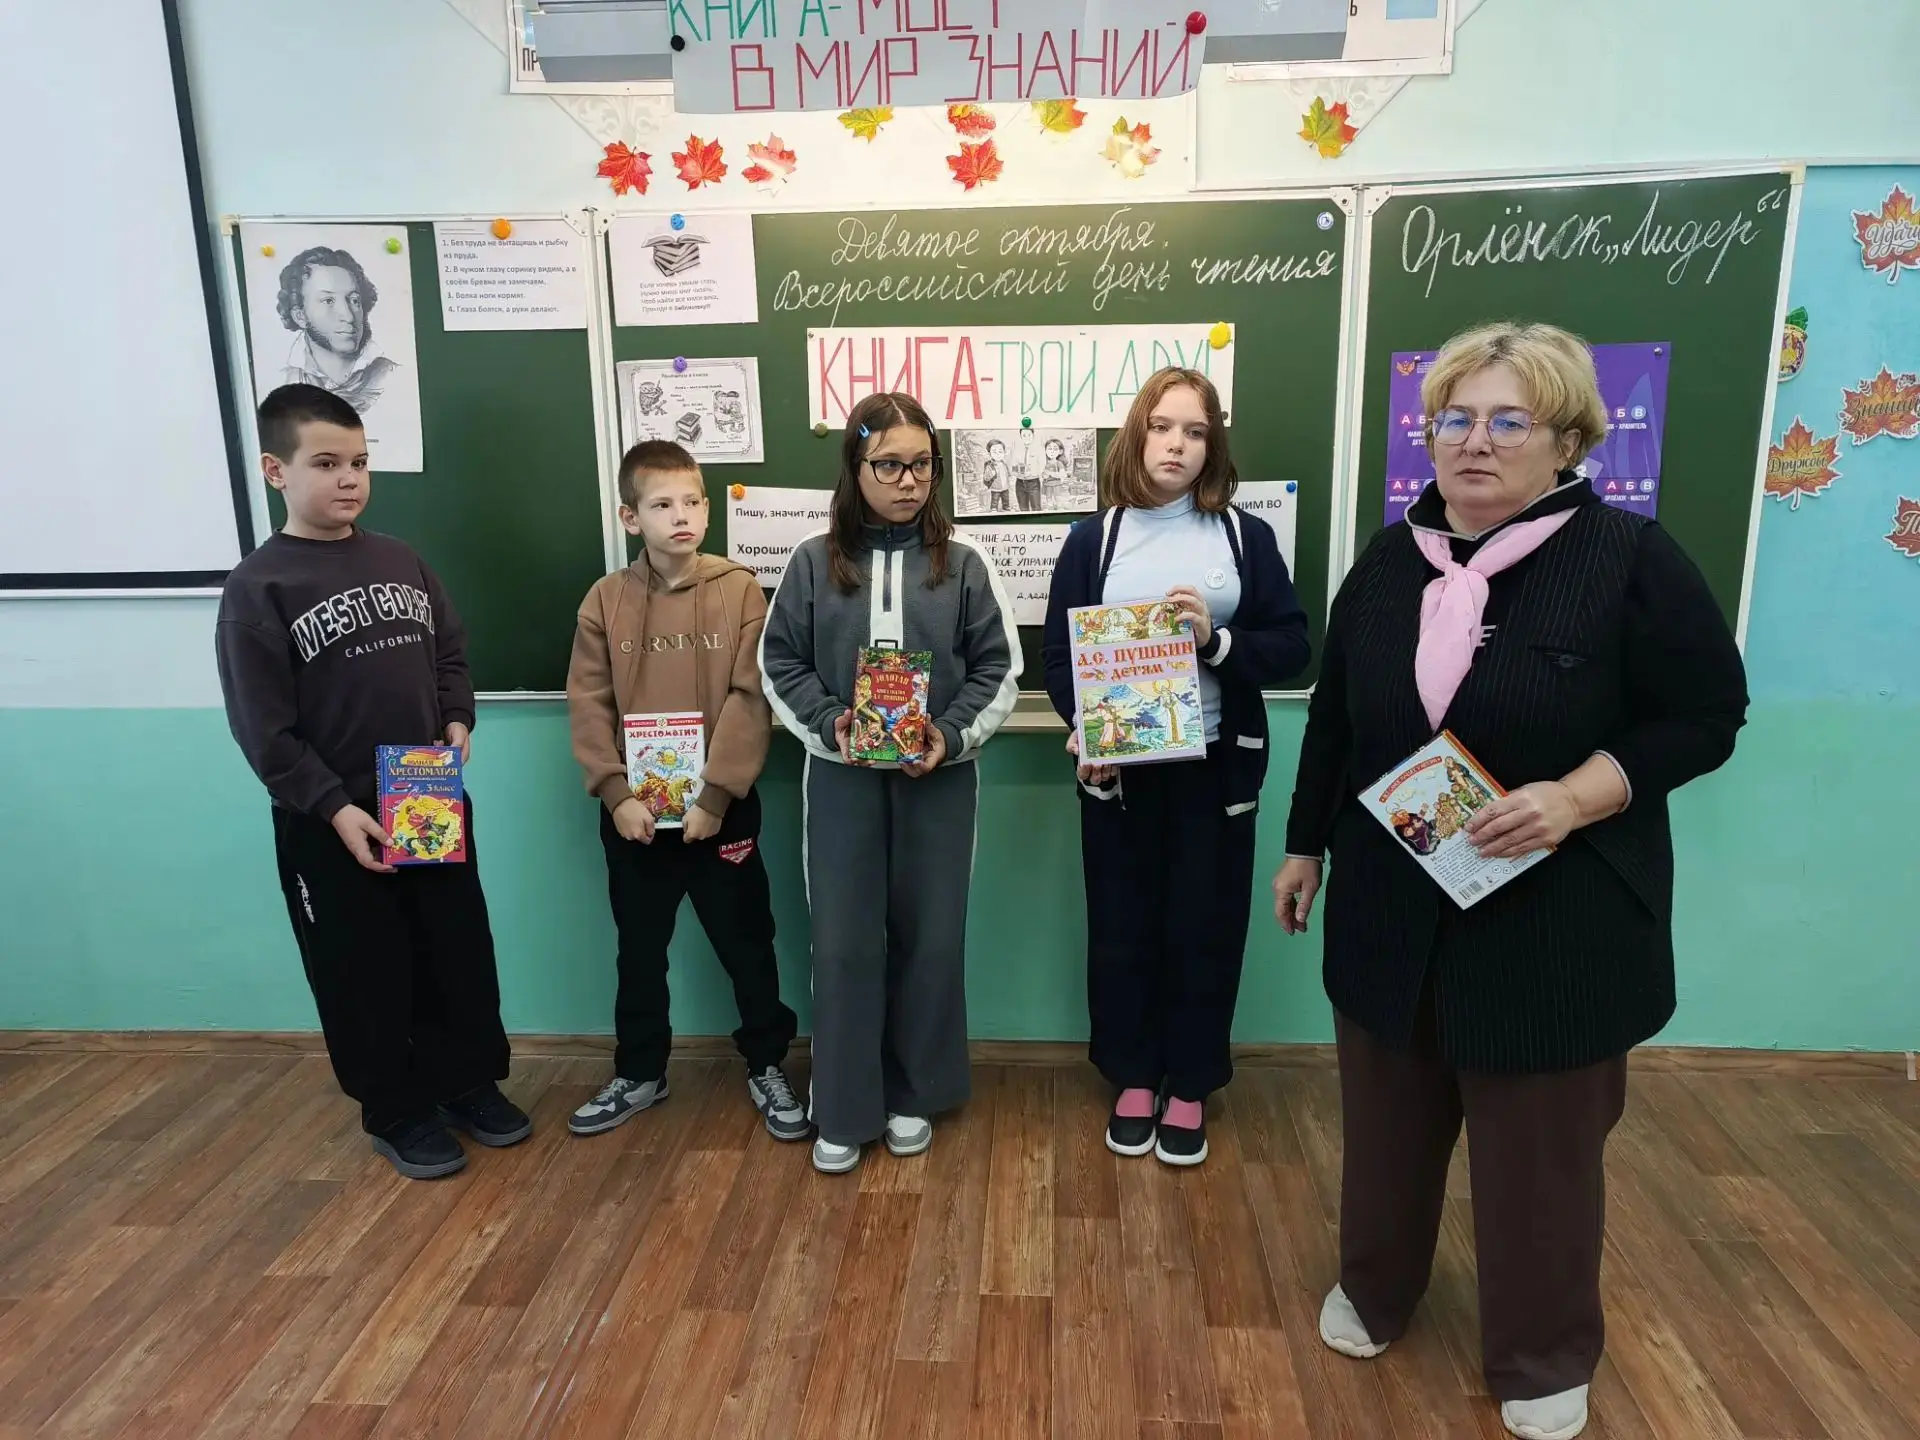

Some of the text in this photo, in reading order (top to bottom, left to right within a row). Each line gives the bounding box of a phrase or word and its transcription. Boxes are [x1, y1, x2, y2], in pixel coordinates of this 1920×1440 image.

[731, 44, 775, 111] В
[796, 39, 919, 109] МИР
[830, 212, 980, 266] Девятое
[1402, 204, 1612, 298] Орлёнок
[773, 248, 1338, 327] Всероссийский день чтения
[1767, 451, 1826, 477] Дружбы
[1607, 481, 1652, 490] А Б В
[736, 508, 767, 519] Пишу,
[770, 510, 805, 518] значит
[1003, 534, 1026, 543] ДЛЯ
[1003, 547, 1026, 556] ЧТО
[290, 587, 372, 663] WEST
[345, 633, 422, 658] CALIFORNIA
[620, 633, 724, 655] CARNIVAL
[1114, 641, 1194, 665] ПУШКИН
[388, 767, 458, 776] ХРЕСТОМАТИЯ
[721, 838, 752, 852] RACING
